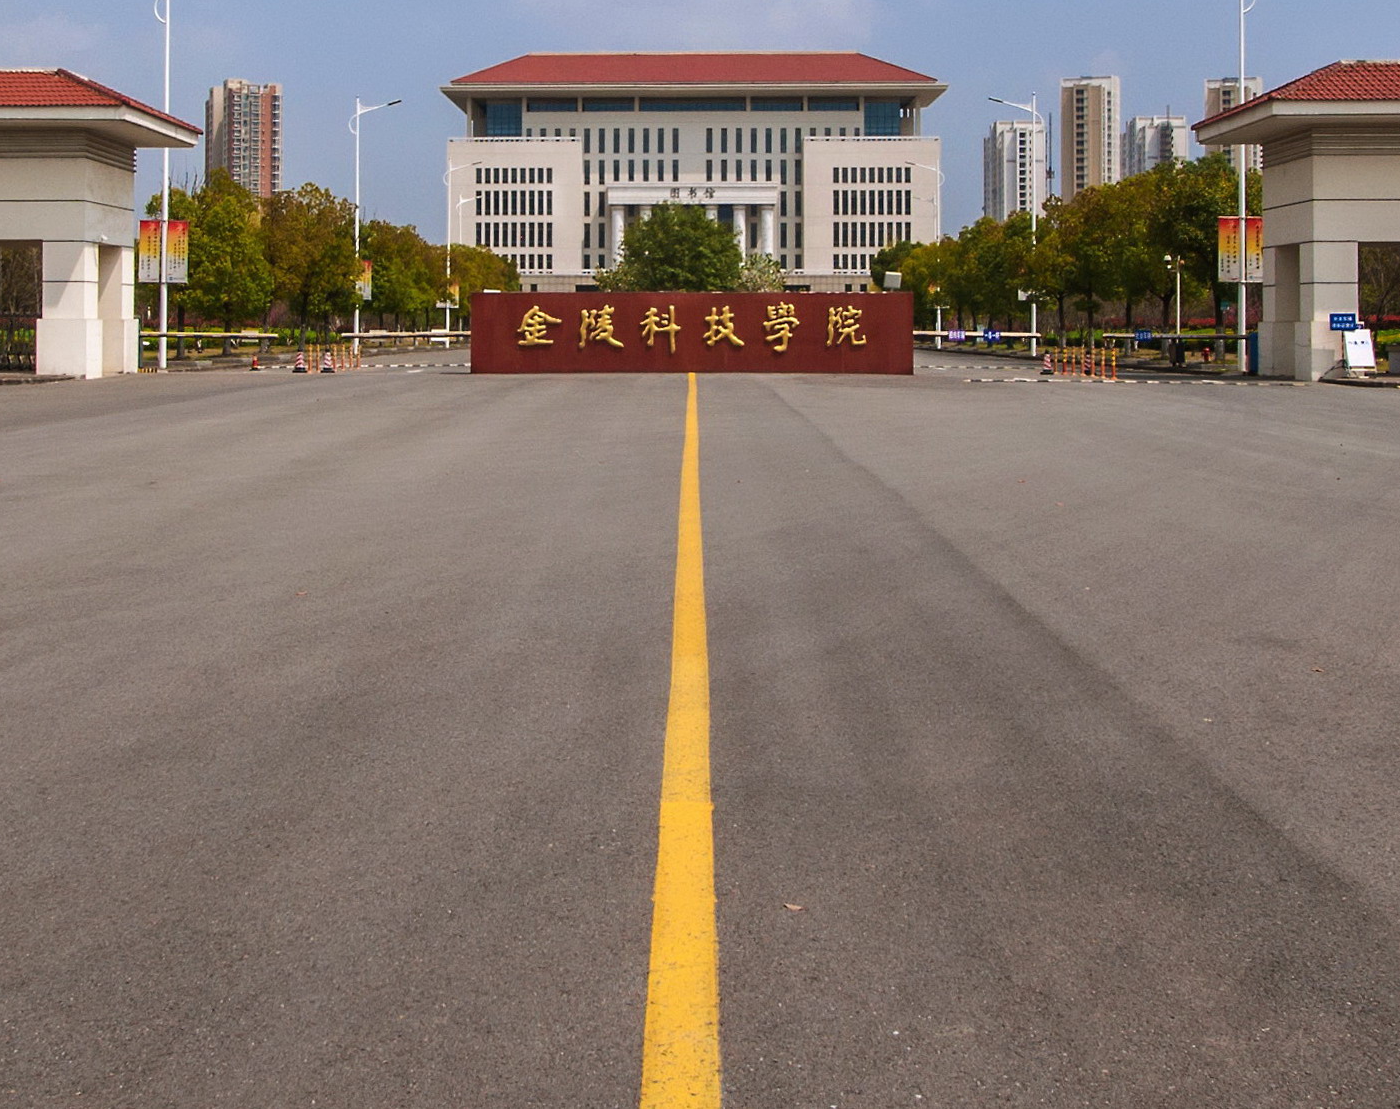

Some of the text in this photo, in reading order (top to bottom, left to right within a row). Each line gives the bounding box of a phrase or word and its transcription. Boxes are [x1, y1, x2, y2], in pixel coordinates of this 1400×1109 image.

[517, 301, 866, 354] 金陵科技學院
